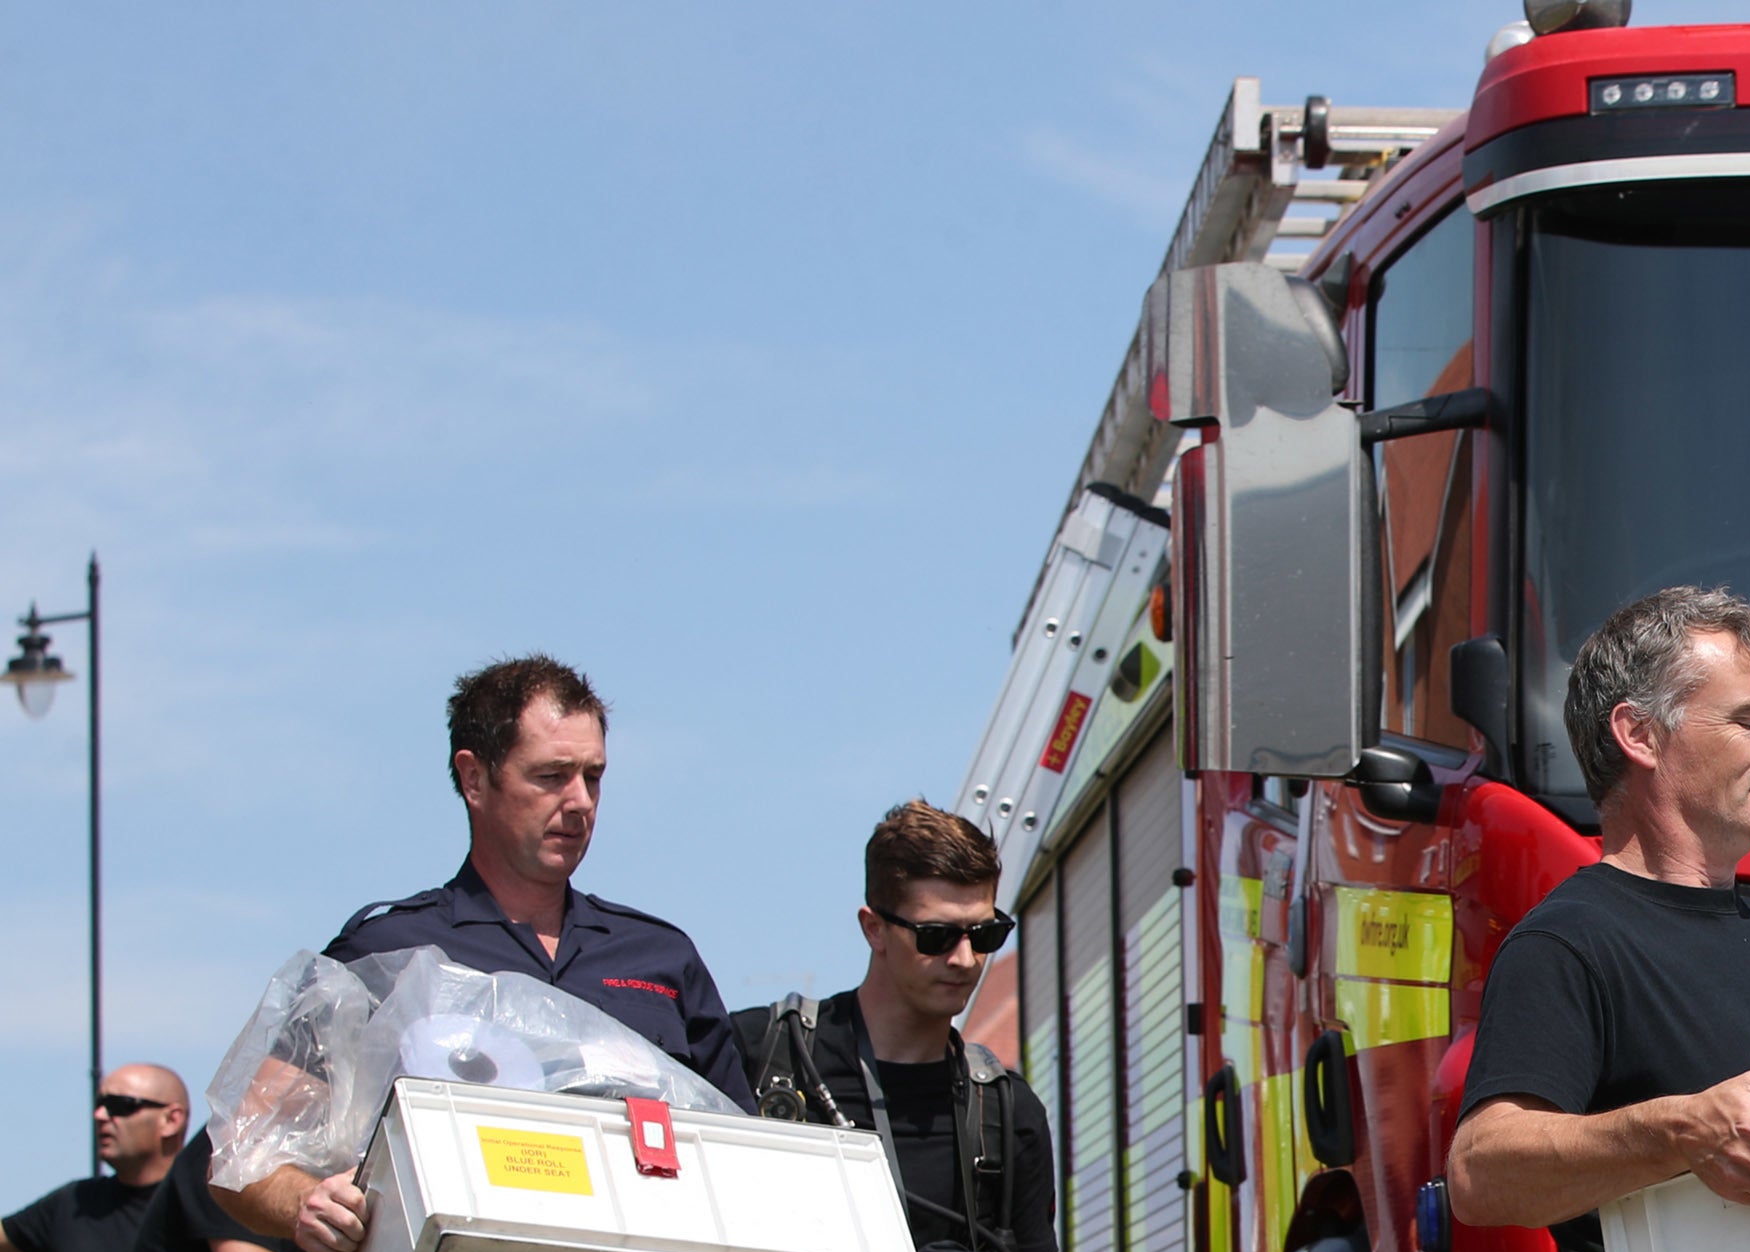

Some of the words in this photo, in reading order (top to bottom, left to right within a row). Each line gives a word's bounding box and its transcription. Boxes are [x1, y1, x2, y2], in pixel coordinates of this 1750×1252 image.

[1052, 697, 1086, 753] Bayley
[506, 1155, 535, 1166] BLUE
[537, 1159, 566, 1169] ROLL
[504, 1165, 541, 1175] UNDER
[544, 1168, 571, 1178] SEAT
